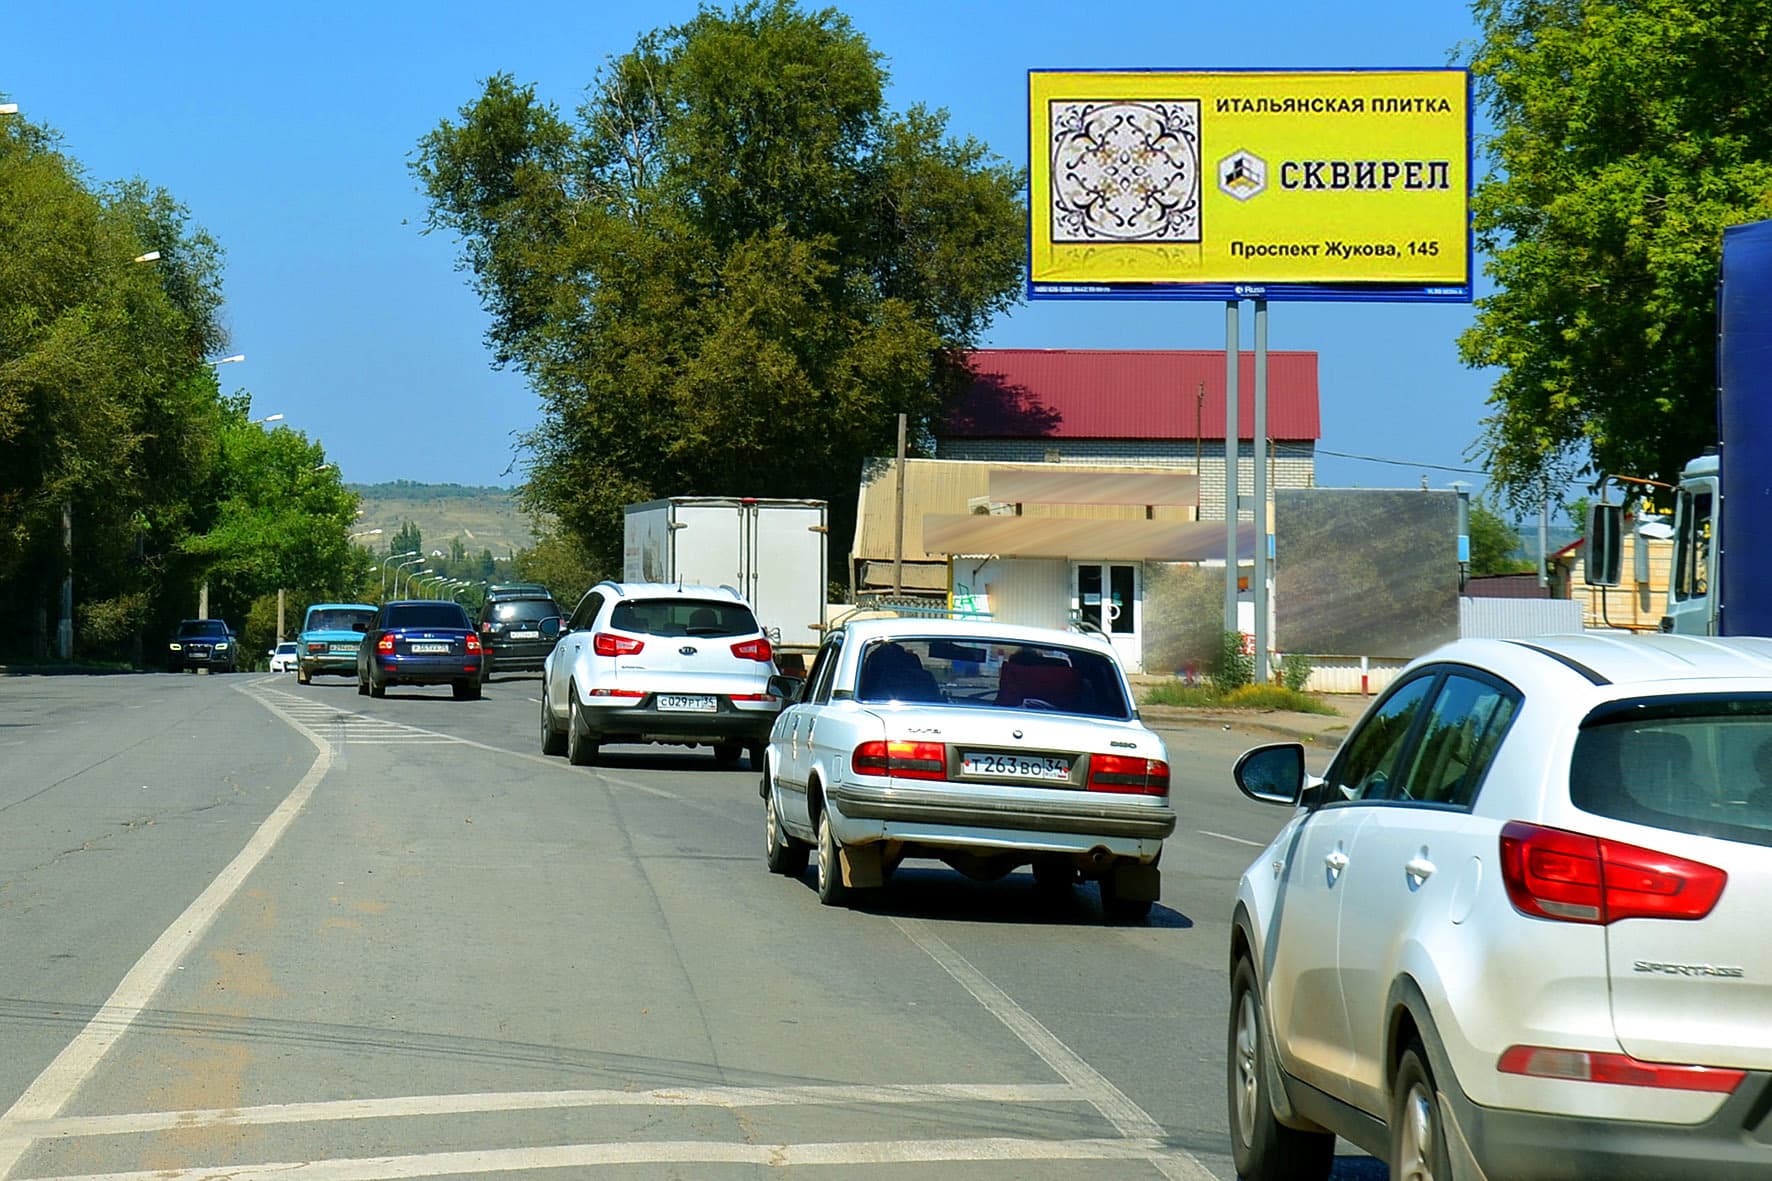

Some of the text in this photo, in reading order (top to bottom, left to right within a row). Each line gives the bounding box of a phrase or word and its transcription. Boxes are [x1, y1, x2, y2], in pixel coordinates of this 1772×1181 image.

[1215, 97, 1451, 114] ИТАЛЬЯНСКАЯ ПЛИТКА
[1279, 160, 1450, 191] СКВИРЕЛ
[1230, 240, 1440, 260] Проспект Жукова, 145
